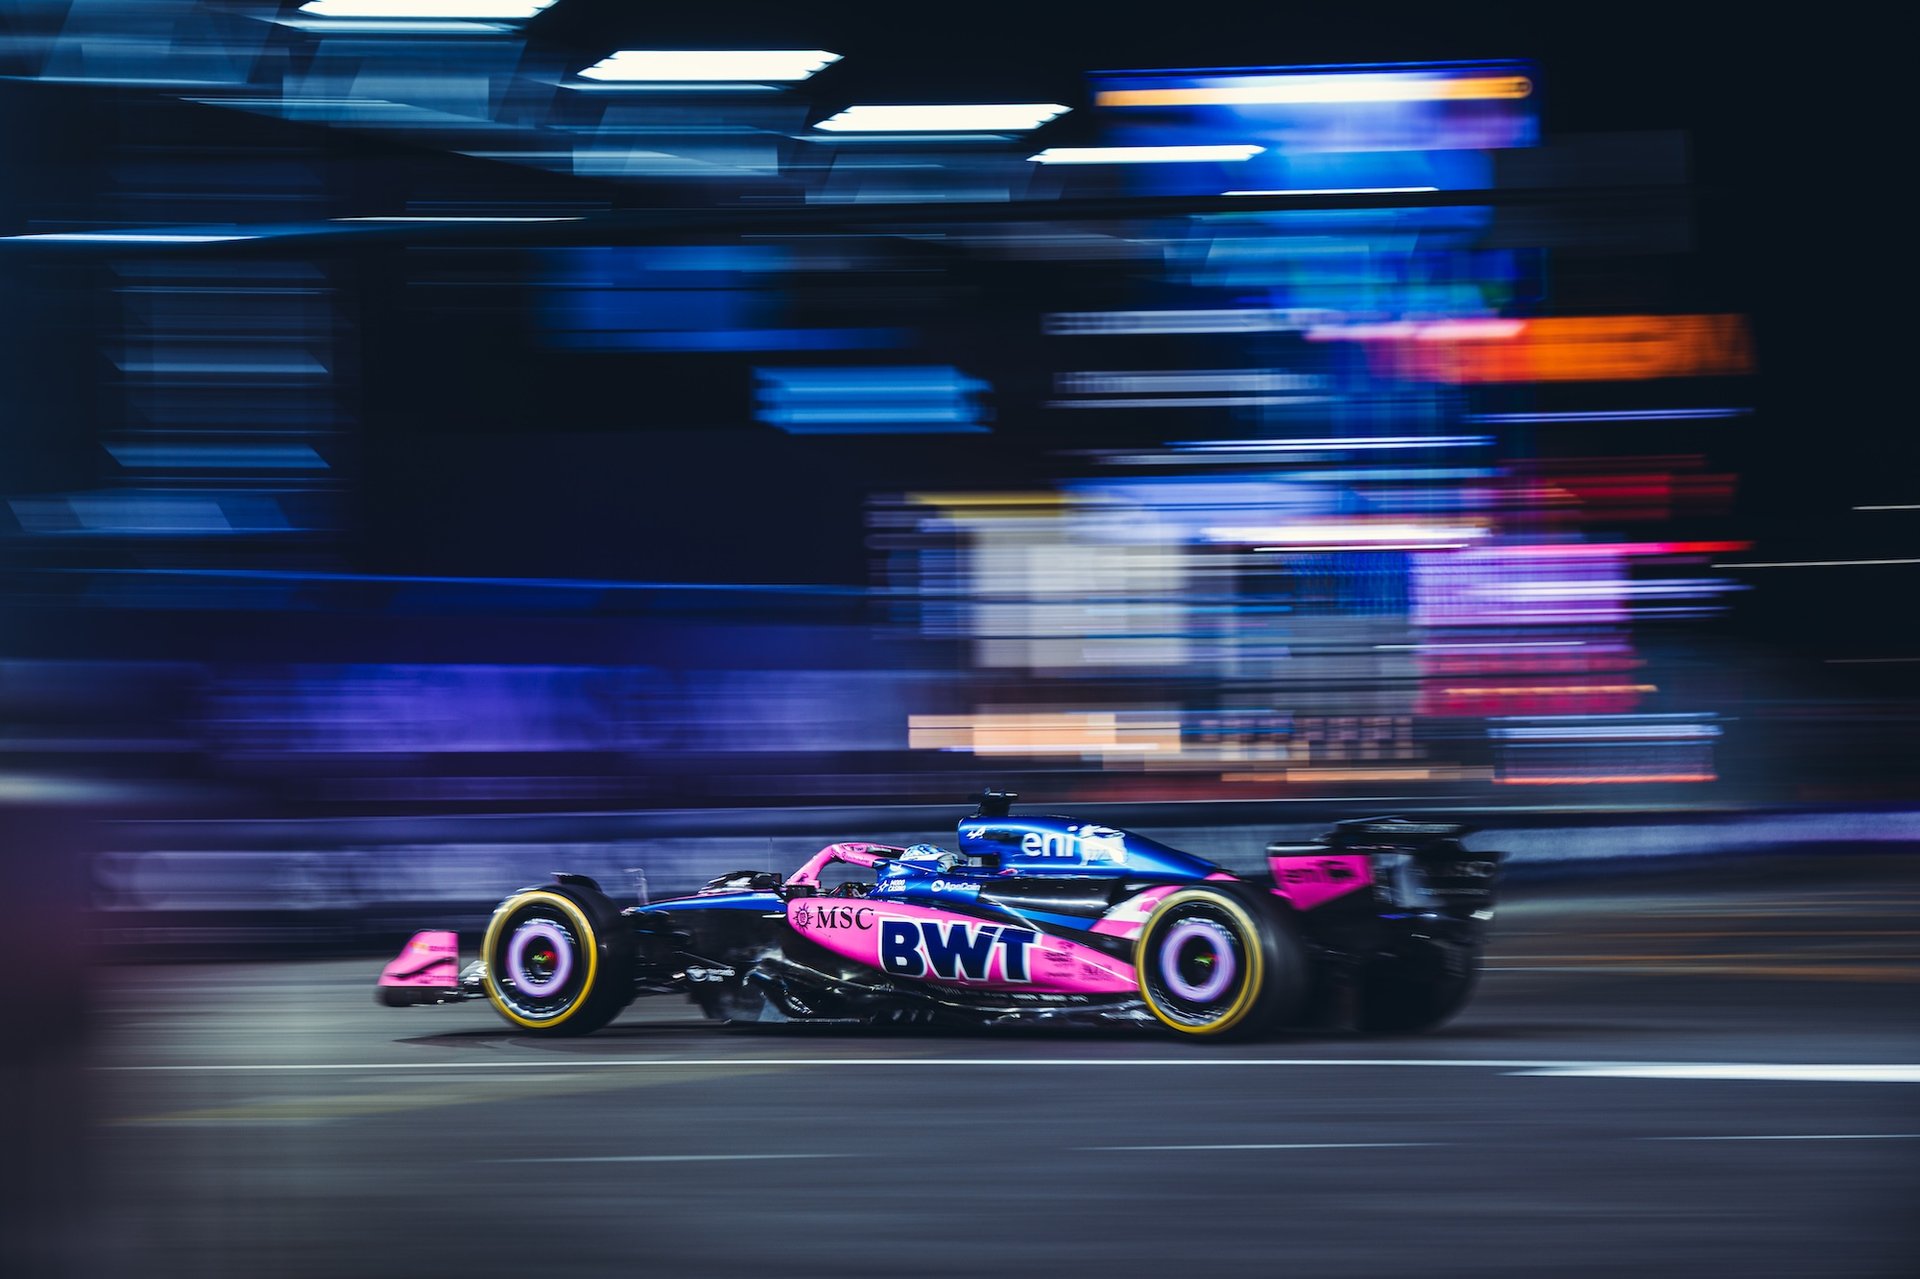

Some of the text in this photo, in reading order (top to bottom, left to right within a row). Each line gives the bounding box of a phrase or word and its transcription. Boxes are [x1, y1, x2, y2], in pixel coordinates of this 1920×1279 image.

[1021, 825, 1079, 857] eni
[816, 906, 874, 930] MSC
[879, 917, 1041, 983] BWT
